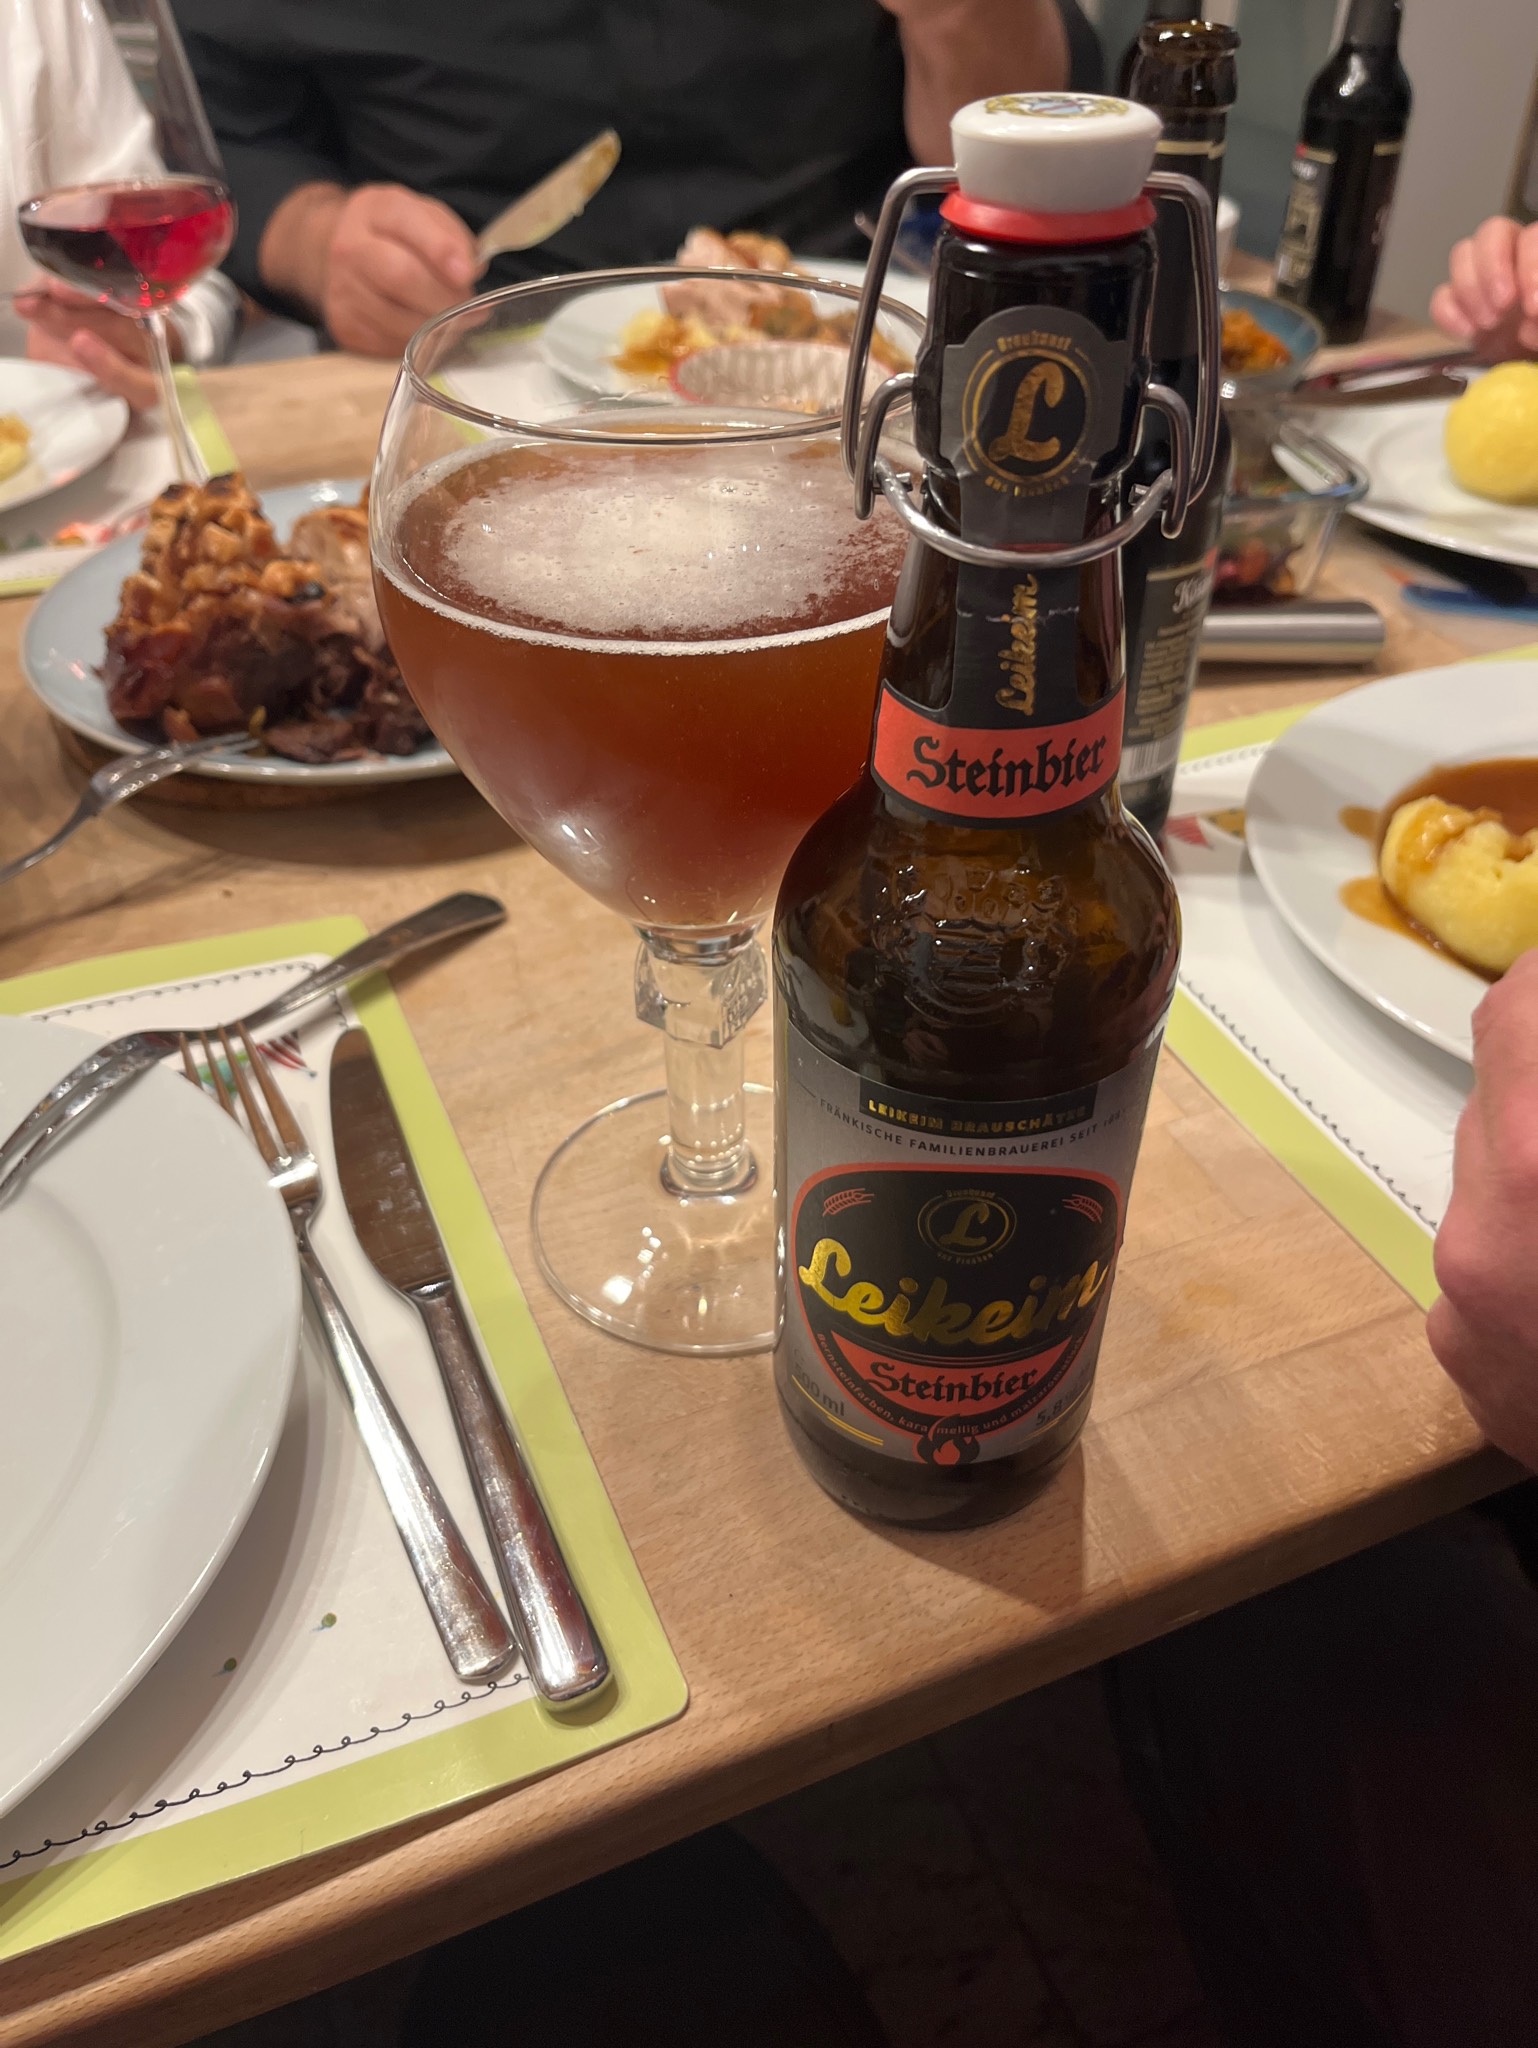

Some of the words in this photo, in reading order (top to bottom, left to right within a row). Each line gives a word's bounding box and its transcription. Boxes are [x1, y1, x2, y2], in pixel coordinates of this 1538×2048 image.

[988, 361, 1066, 462] L
[995, 573, 1039, 716] Leikeim
[906, 735, 1107, 799] Steinbier
[819, 1098, 903, 1145] FRÄNKISCHE
[909, 1136, 1065, 1157] FAMILIENBRAUEREI
[1069, 1124, 1098, 1144] SEIT
[868, 1099, 944, 1132] LEIKEIM
[939, 1202, 990, 1247] L
[798, 1238, 1109, 1345] Leikeim
[865, 1361, 1039, 1404] Steinbier
[982, 1413, 1008, 1430] und
